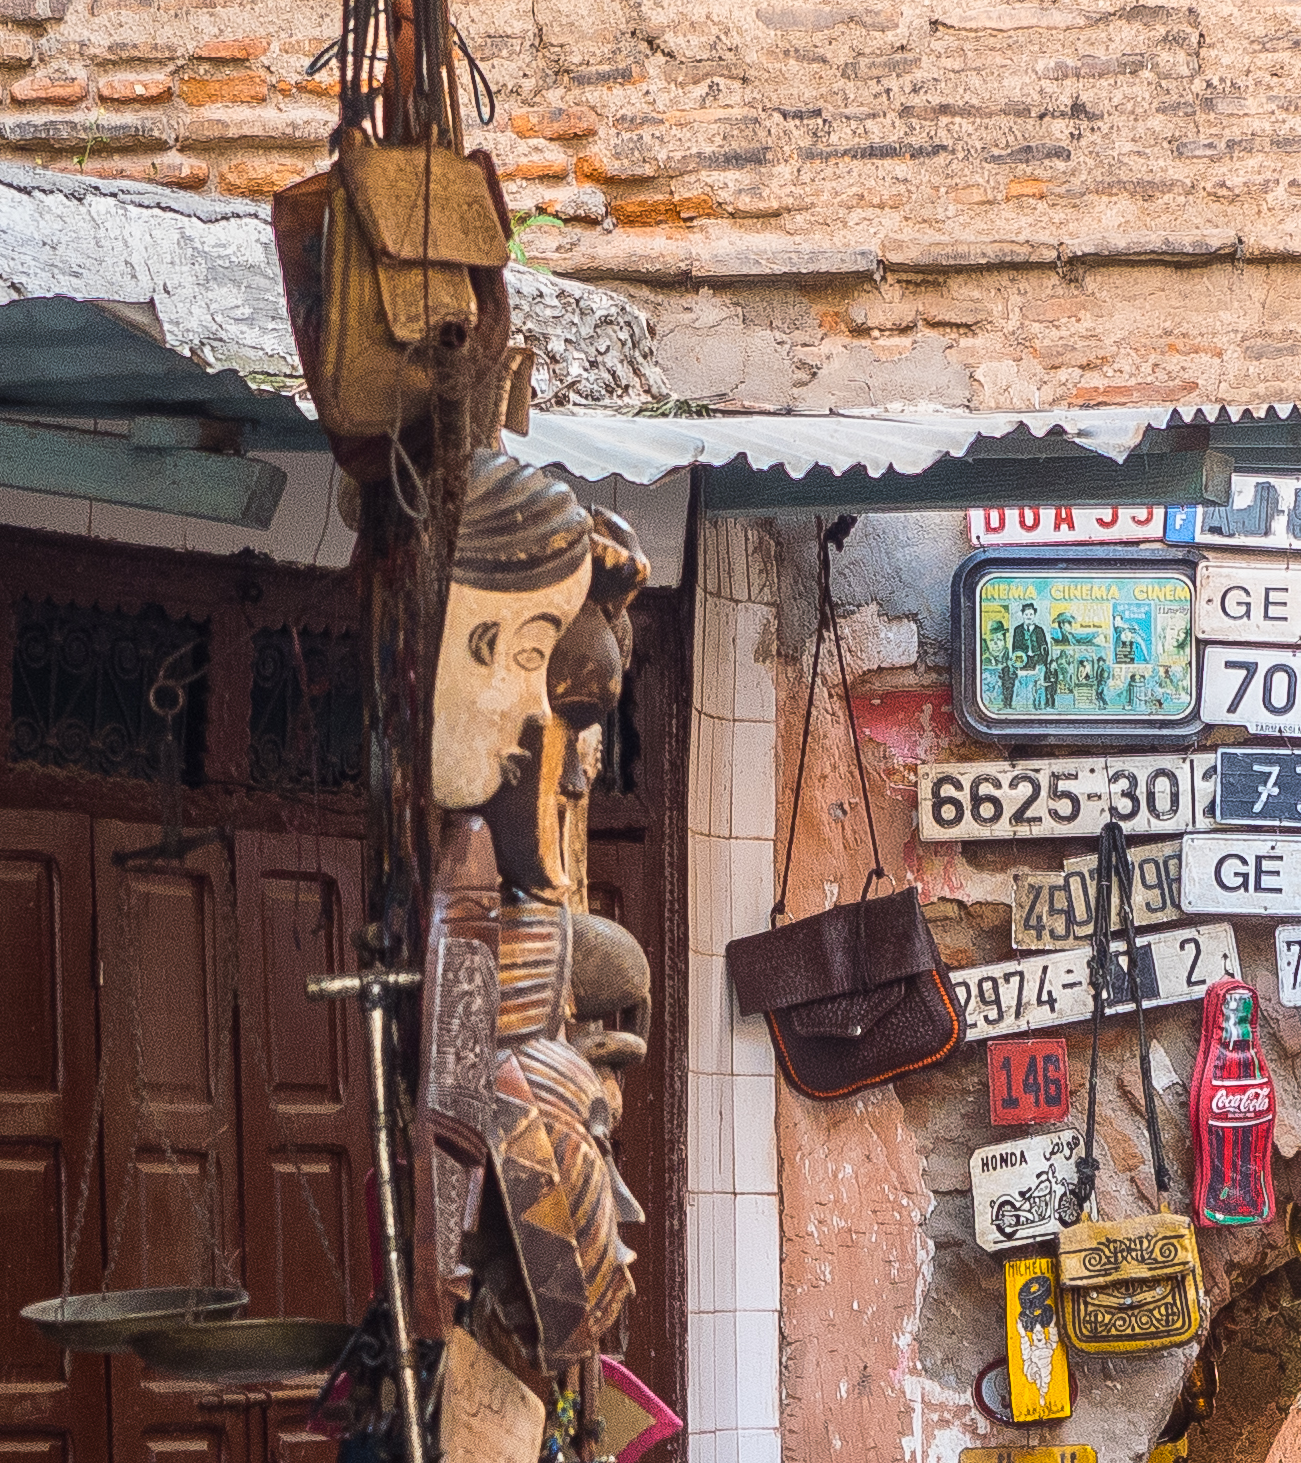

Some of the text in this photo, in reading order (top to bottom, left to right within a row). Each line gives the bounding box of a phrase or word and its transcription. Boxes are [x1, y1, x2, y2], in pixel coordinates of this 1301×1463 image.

[1050, 583, 1121, 600] CINEMA
[1220, 586, 1290, 623] GE
[931, 767, 1180, 830] 6625-30
[1214, 853, 1284, 895] GE
[1000, 1053, 1062, 1110] 146
[1211, 1089, 1271, 1114] Coca-Cola
[980, 1149, 1029, 1174] HONDA
